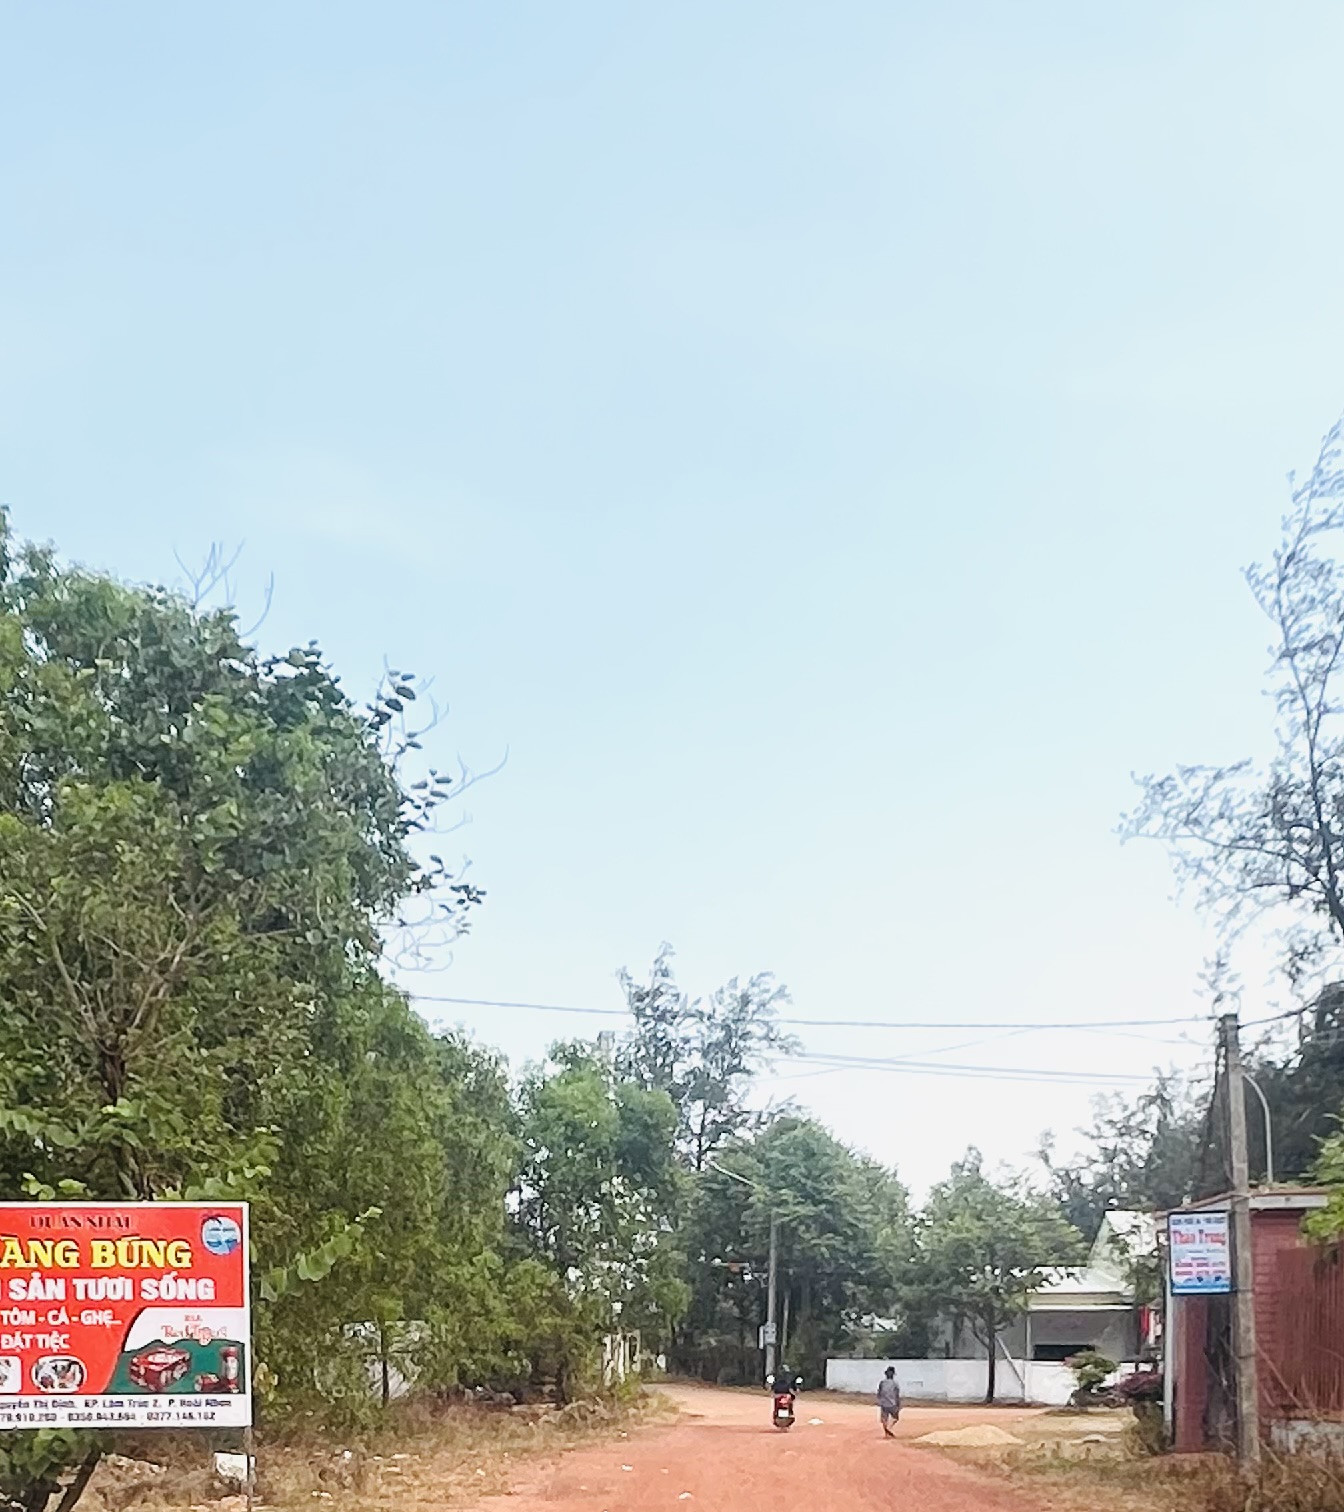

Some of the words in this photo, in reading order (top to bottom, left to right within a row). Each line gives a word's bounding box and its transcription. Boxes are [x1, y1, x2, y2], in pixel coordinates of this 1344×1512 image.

[8, 1271, 66, 1301] SẢN
[72, 1276, 134, 1301] TƯƠI
[141, 1270, 216, 1301] SỐNG
[0, 1306, 36, 1326] TÔM
[47, 1306, 68, 1326] CÁ
[36, 1331, 70, 1352] TIỆC
